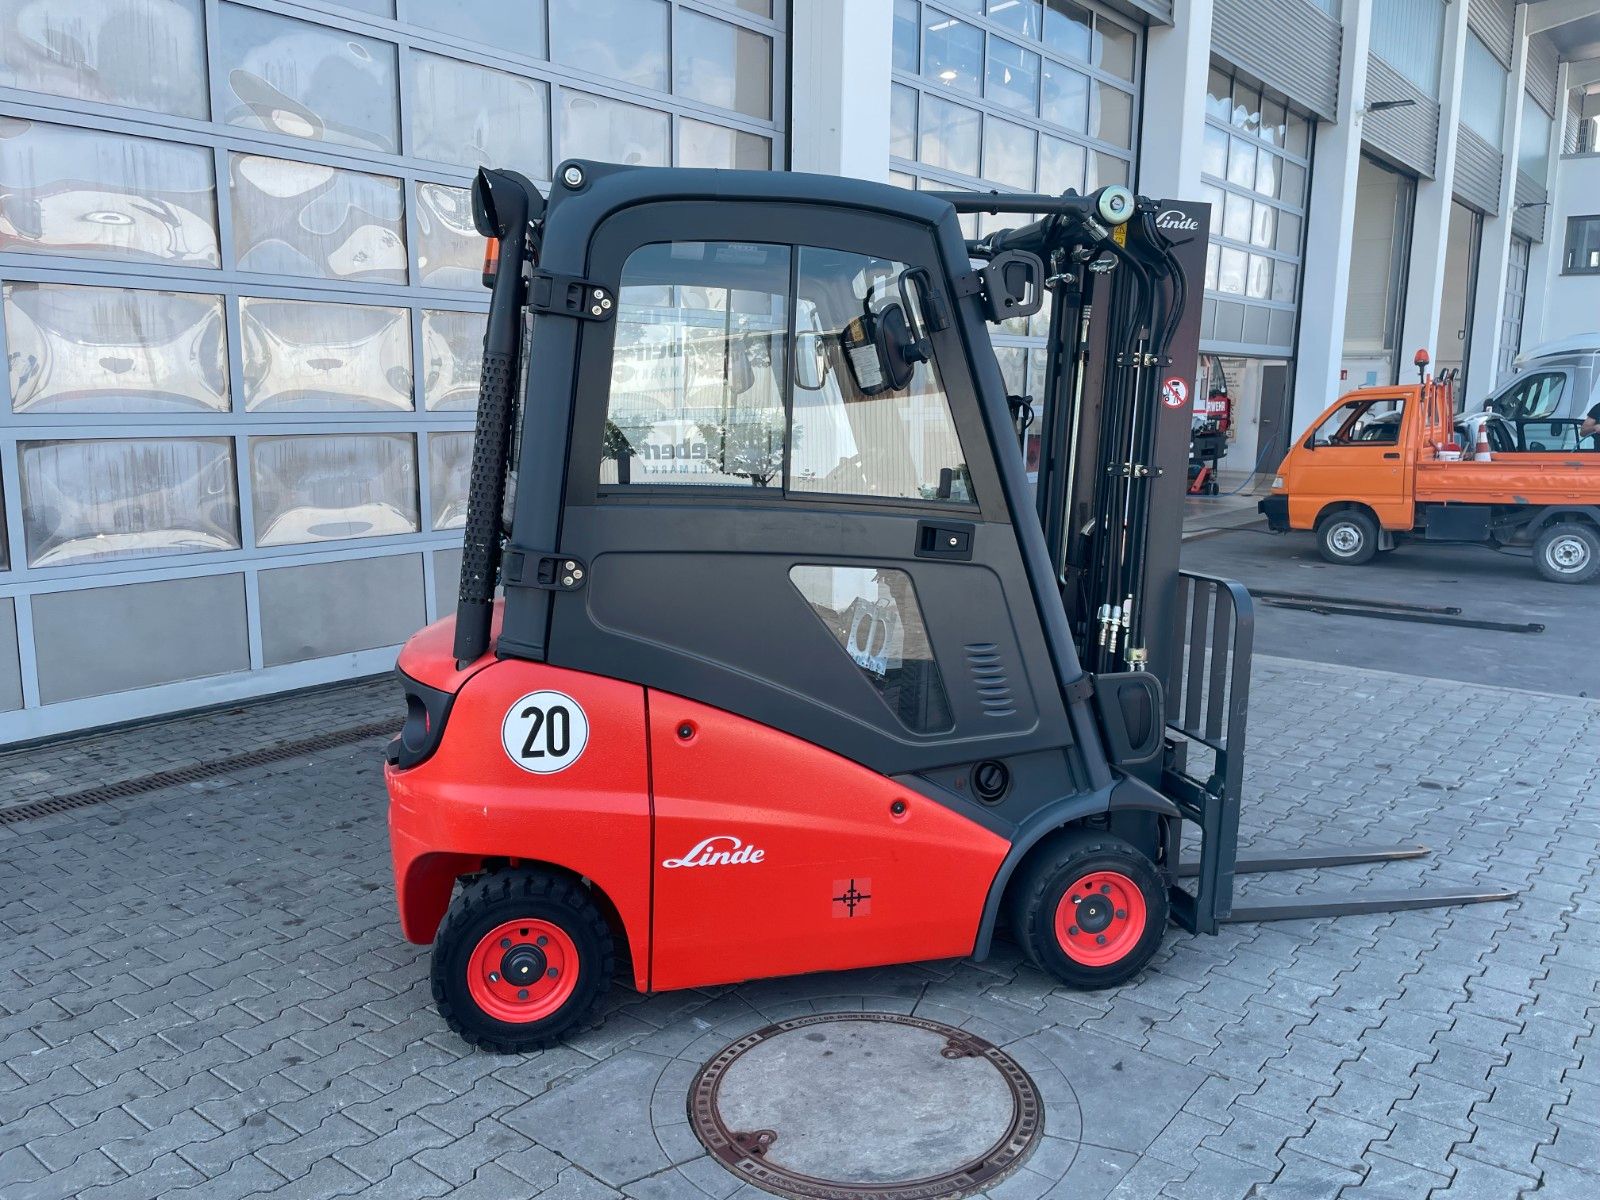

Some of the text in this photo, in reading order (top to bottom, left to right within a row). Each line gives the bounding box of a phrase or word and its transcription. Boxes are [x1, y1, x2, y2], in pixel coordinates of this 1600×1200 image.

[1155, 210, 1199, 230] Linde
[520, 705, 570, 759] 20
[662, 835, 766, 869] Linde
